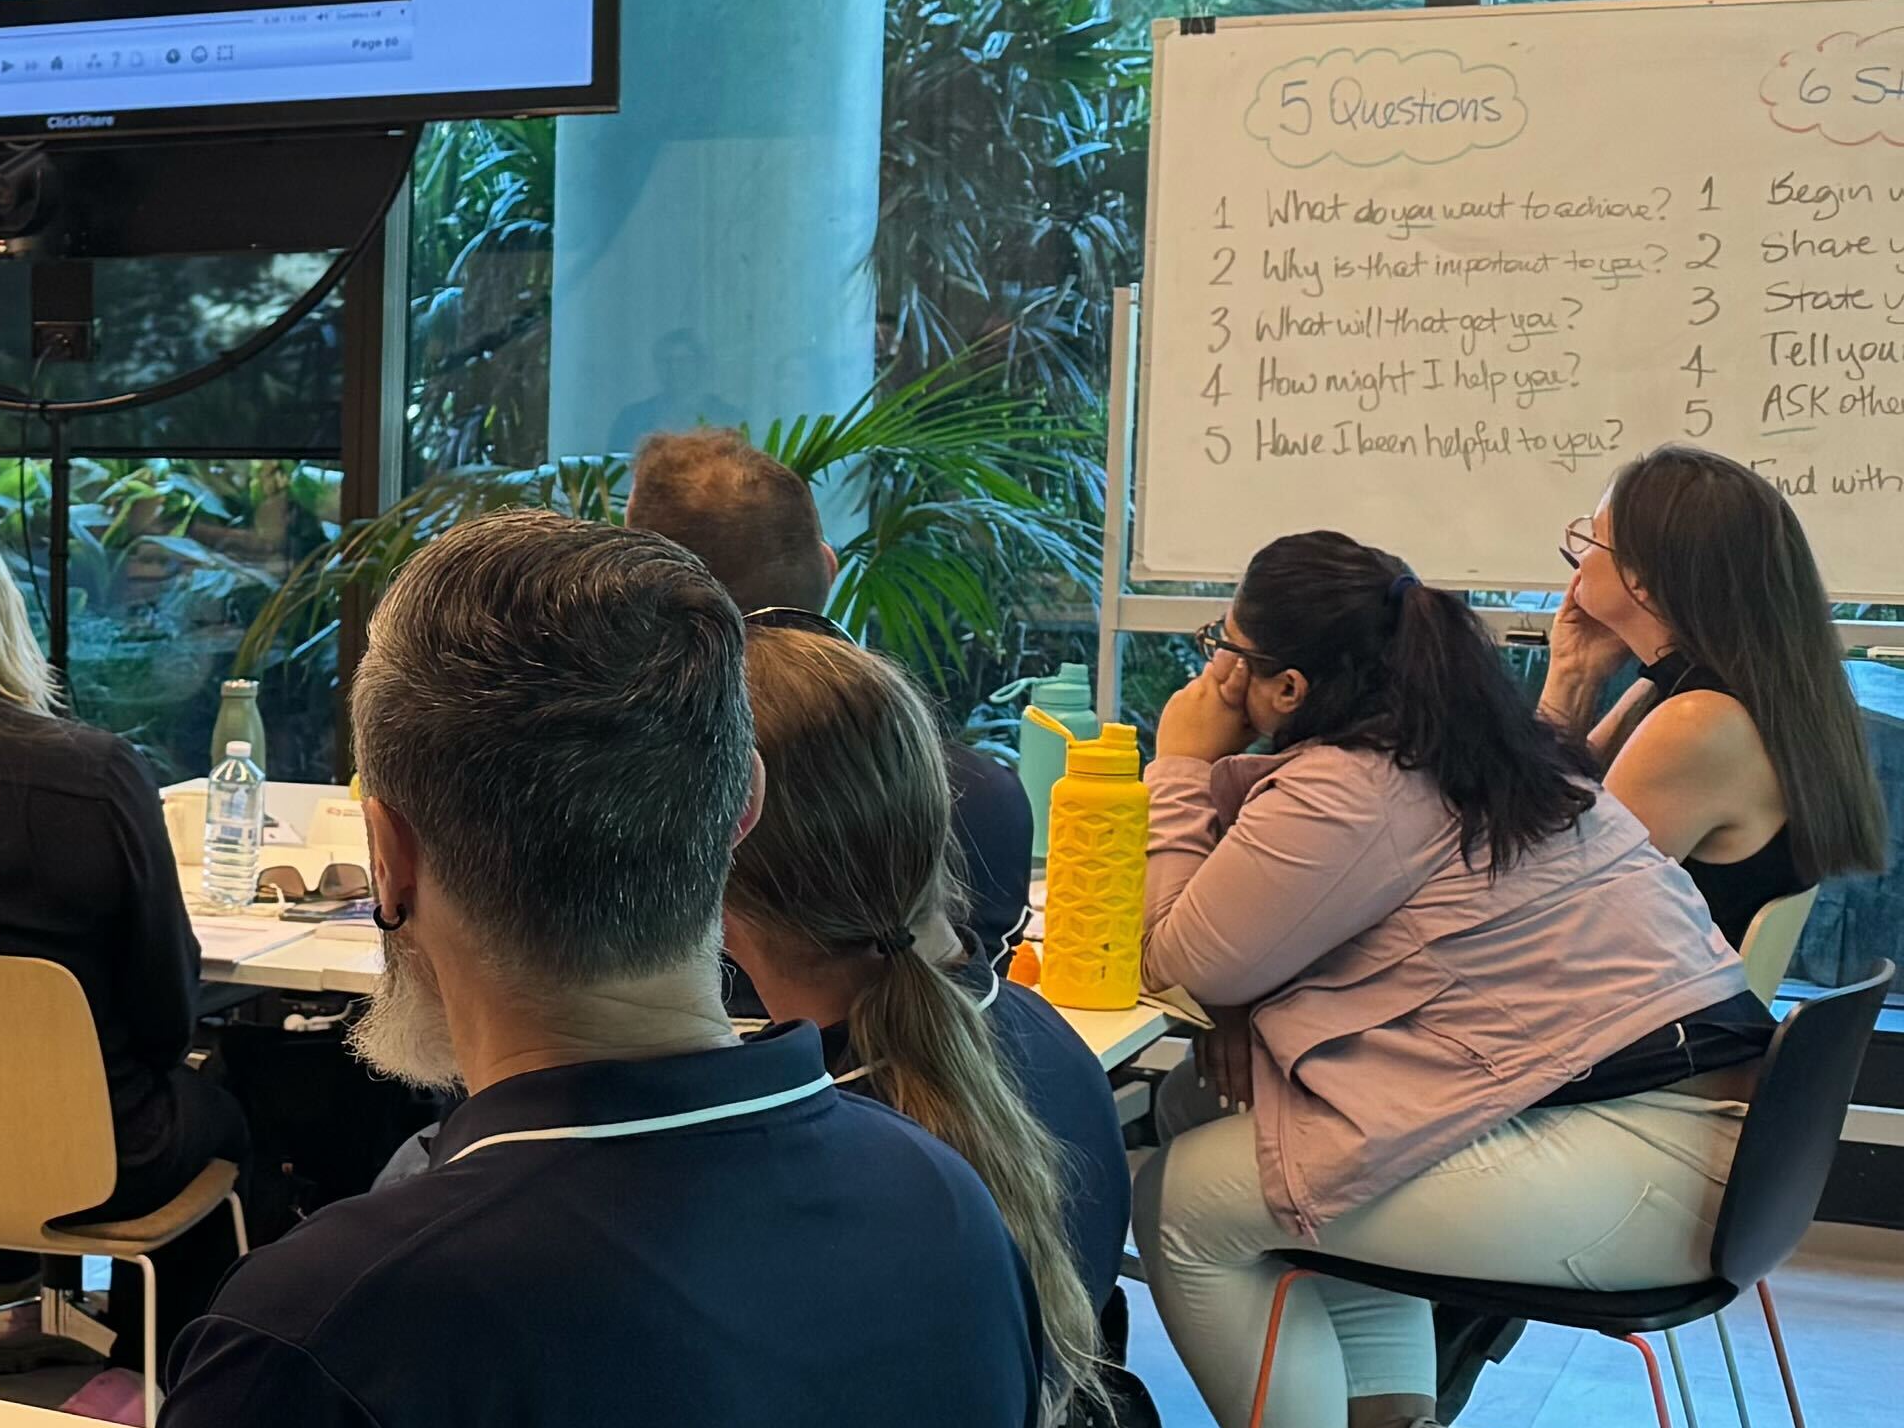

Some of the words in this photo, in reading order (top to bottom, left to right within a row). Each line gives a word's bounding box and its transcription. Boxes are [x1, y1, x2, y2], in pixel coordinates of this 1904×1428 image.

[1279, 79, 1313, 136] 5
[1329, 76, 1504, 131] Questions
[1799, 67, 1832, 104] 6
[1851, 66, 1904, 104] St
[1213, 194, 1235, 230] 1
[1266, 187, 1352, 228] What
[1353, 197, 1387, 225] do
[1386, 203, 1437, 241] you
[1441, 190, 1515, 220] want
[1519, 190, 1550, 220] to
[1697, 175, 1722, 212] 1
[1766, 171, 1873, 222] Begin
[1208, 246, 1236, 286] 2
[1262, 246, 1324, 298] Why
[1333, 255, 1356, 279] is
[1356, 250, 1430, 280] that
[1563, 248, 1596, 272] to
[1596, 243, 1669, 291] you?
[1684, 232, 1722, 270] 2
[1760, 229, 1878, 264] Share
[1207, 306, 1232, 354] 3
[1255, 305, 1333, 343] What
[1337, 305, 1383, 339] will
[1385, 306, 1459, 340] that
[1460, 306, 1507, 356] get
[1506, 296, 1584, 353] you?
[1688, 286, 1721, 326] 3
[1763, 280, 1875, 314] State
[1200, 362, 1233, 407] 4
[1257, 356, 1317, 402] How
[1325, 359, 1416, 412] might
[1422, 358, 1445, 390] I
[1454, 359, 1508, 404] help
[1679, 344, 1717, 389] 4
[1760, 330, 1829, 367] Tell
[1836, 340, 1904, 381] you
[1683, 399, 1713, 438] 5
[1760, 383, 1830, 424] ASK
[1204, 425, 1232, 466] 5
[1255, 417, 1324, 462] Have
[1332, 420, 1353, 456] I
[1357, 423, 1418, 456] been
[1424, 420, 1512, 473] helpful
[1516, 427, 1548, 453] to
[1549, 418, 1624, 473] you?
[1832, 463, 1904, 494] with
